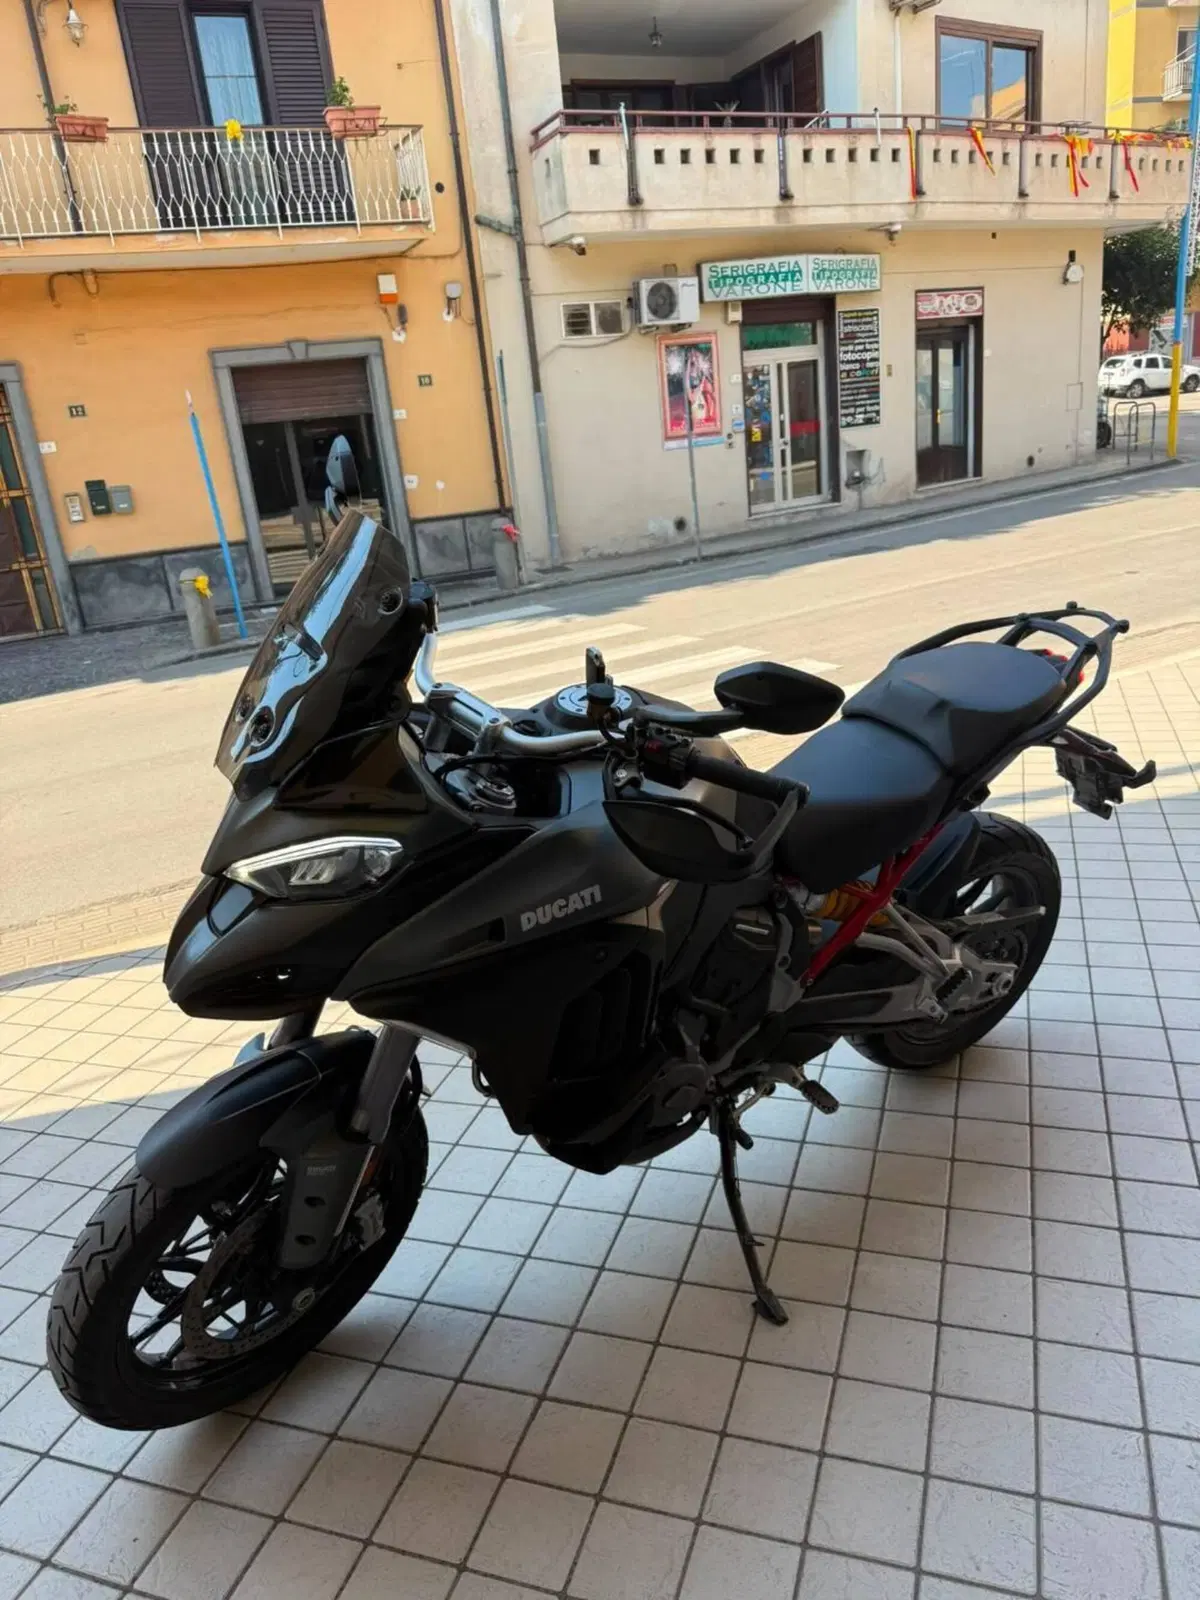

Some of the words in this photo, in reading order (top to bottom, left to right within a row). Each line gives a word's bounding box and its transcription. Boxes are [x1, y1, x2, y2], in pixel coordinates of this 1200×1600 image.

[709, 260, 801, 277] SERIGRAFIA
[812, 257, 877, 270] SERIGRAFIA
[709, 272, 802, 289] TIPOGRAFIA
[812, 269, 877, 280] TIPOGRAFIA
[711, 284, 803, 298] VARONE
[813, 279, 877, 290] VARONE
[520, 884, 602, 933] DUCATI
